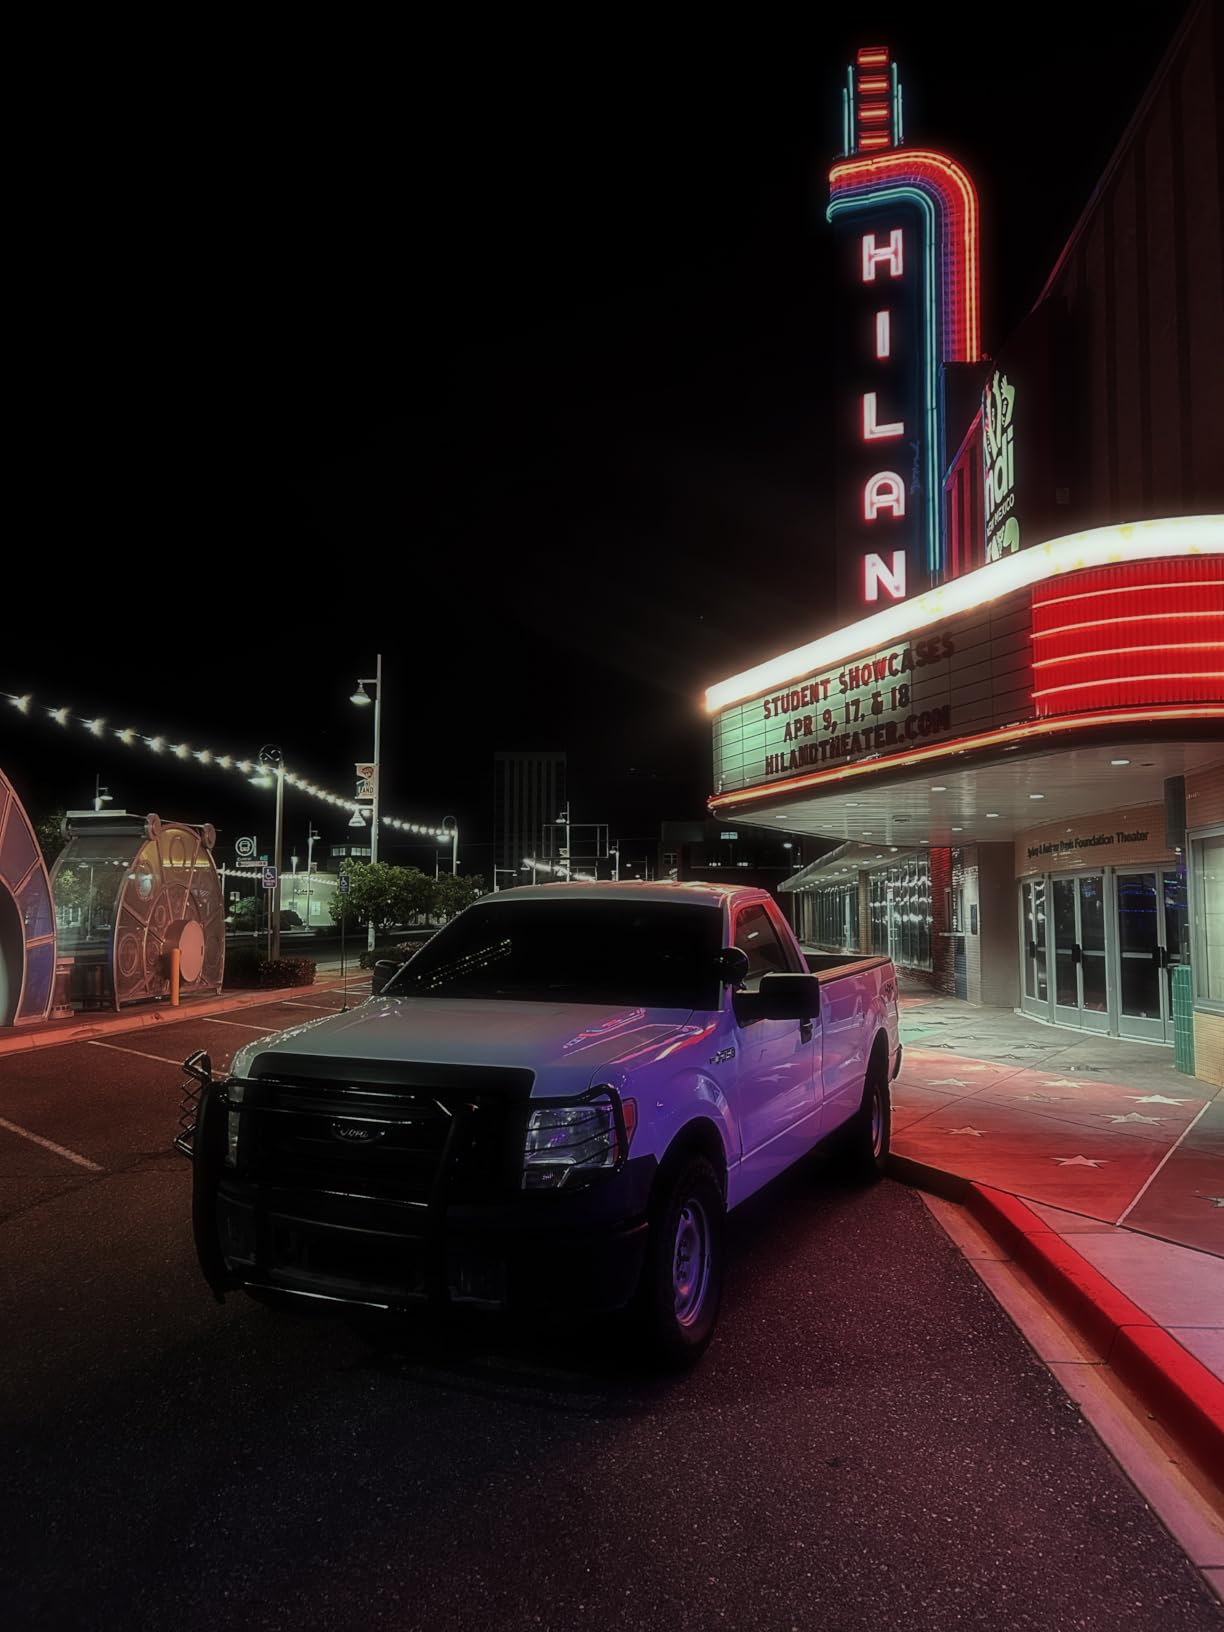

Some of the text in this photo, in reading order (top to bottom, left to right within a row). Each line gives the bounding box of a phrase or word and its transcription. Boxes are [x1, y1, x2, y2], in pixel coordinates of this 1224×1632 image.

[763, 631, 955, 720] STUDENT SHOWCASES
[765, 704, 953, 776] HILANDTHEATER.COM
[784, 714, 813, 743] APR
[822, 708, 838, 735] 9,
[845, 698, 865, 725] 17,
[891, 683, 910, 711] 18
[1074, 834, 1114, 849] Foundation
[1115, 831, 1149, 844] Theater
